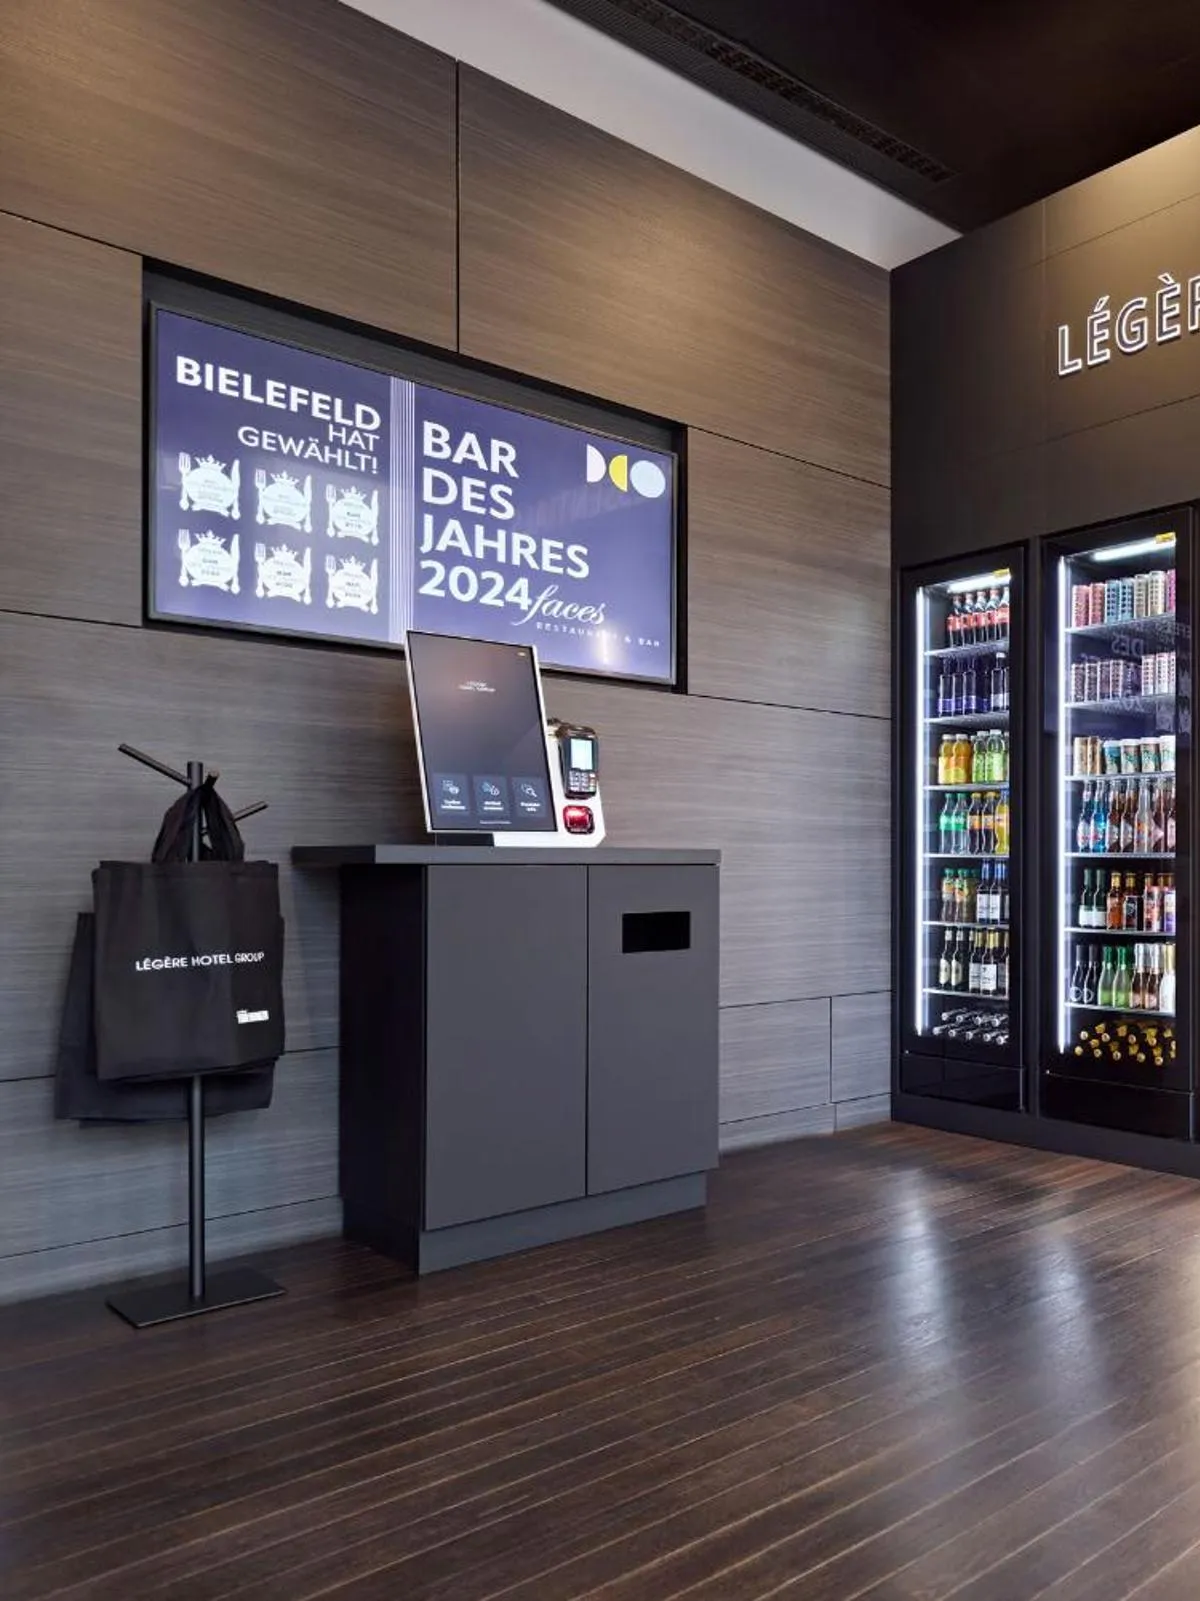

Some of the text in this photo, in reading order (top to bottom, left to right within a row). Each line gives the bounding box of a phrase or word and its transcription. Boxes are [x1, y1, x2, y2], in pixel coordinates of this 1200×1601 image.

[176, 355, 382, 431] BIELEFELD
[237, 425, 379, 475] GEWÄHLT!
[328, 423, 380, 452] HAT
[422, 420, 520, 479] BAR
[423, 466, 515, 521] DES
[419, 513, 590, 579] JAHRES
[418, 558, 533, 611] 2024
[511, 584, 606, 625] faces
[536, 621, 617, 638] RESTAURT
[191, 953, 233, 967] HOTEL
[234, 951, 265, 964] GROUP
